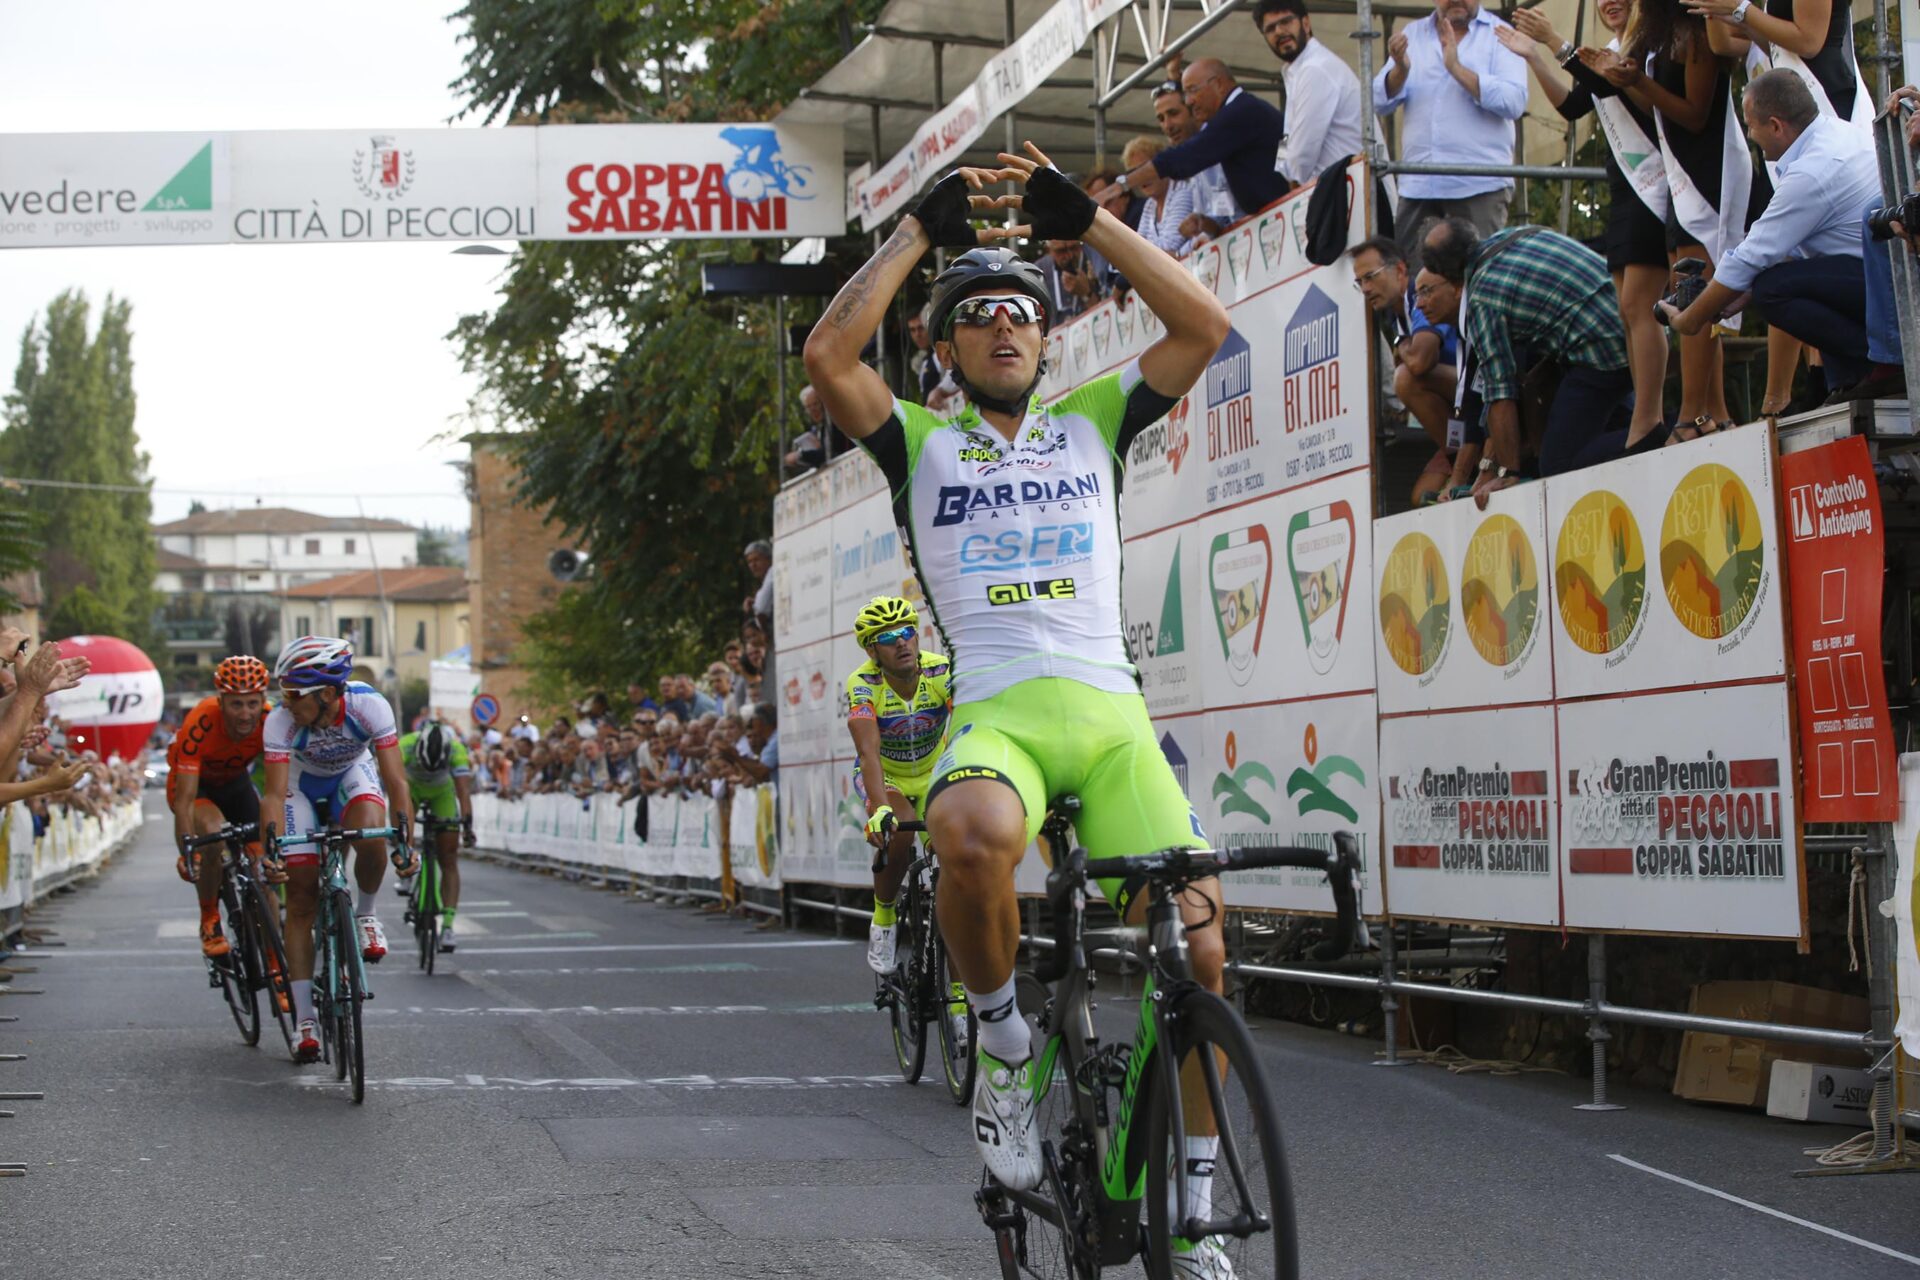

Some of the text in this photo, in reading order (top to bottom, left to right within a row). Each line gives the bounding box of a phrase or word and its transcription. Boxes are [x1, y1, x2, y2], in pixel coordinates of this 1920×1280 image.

[0, 180, 137, 214] vedere
[566, 164, 726, 199] COPPA
[54, 219, 121, 238] progetti
[145, 217, 213, 234] sviluppo
[233, 200, 535, 240] CITTÀ DI PECCIOLI
[566, 196, 788, 234] SABATINI
[1287, 311, 1338, 374] IMPIANTI
[1207, 350, 1249, 404] IMPIANTI
[1132, 423, 1167, 467] GRUPPO
[932, 472, 1100, 527] BARDIANI
[966, 498, 1103, 522] VALVOLE
[1814, 473, 1867, 509] Controllo
[1673, 483, 1714, 540] R&T
[1818, 503, 1873, 539] Antidoping
[1564, 508, 1602, 560] R&T
[181, 713, 215, 758] CCC
[1423, 761, 1510, 798] GranPremio
[1610, 749, 1728, 794] GranPremio
[1449, 803, 1458, 818] di
[1458, 800, 1549, 841] PECCIOLI
[1644, 799, 1656, 816] di
[1657, 792, 1782, 841] PECCIOLI
[1441, 843, 1550, 873] COPPA SABATINI
[1635, 844, 1785, 876] COPPA SABATINI
